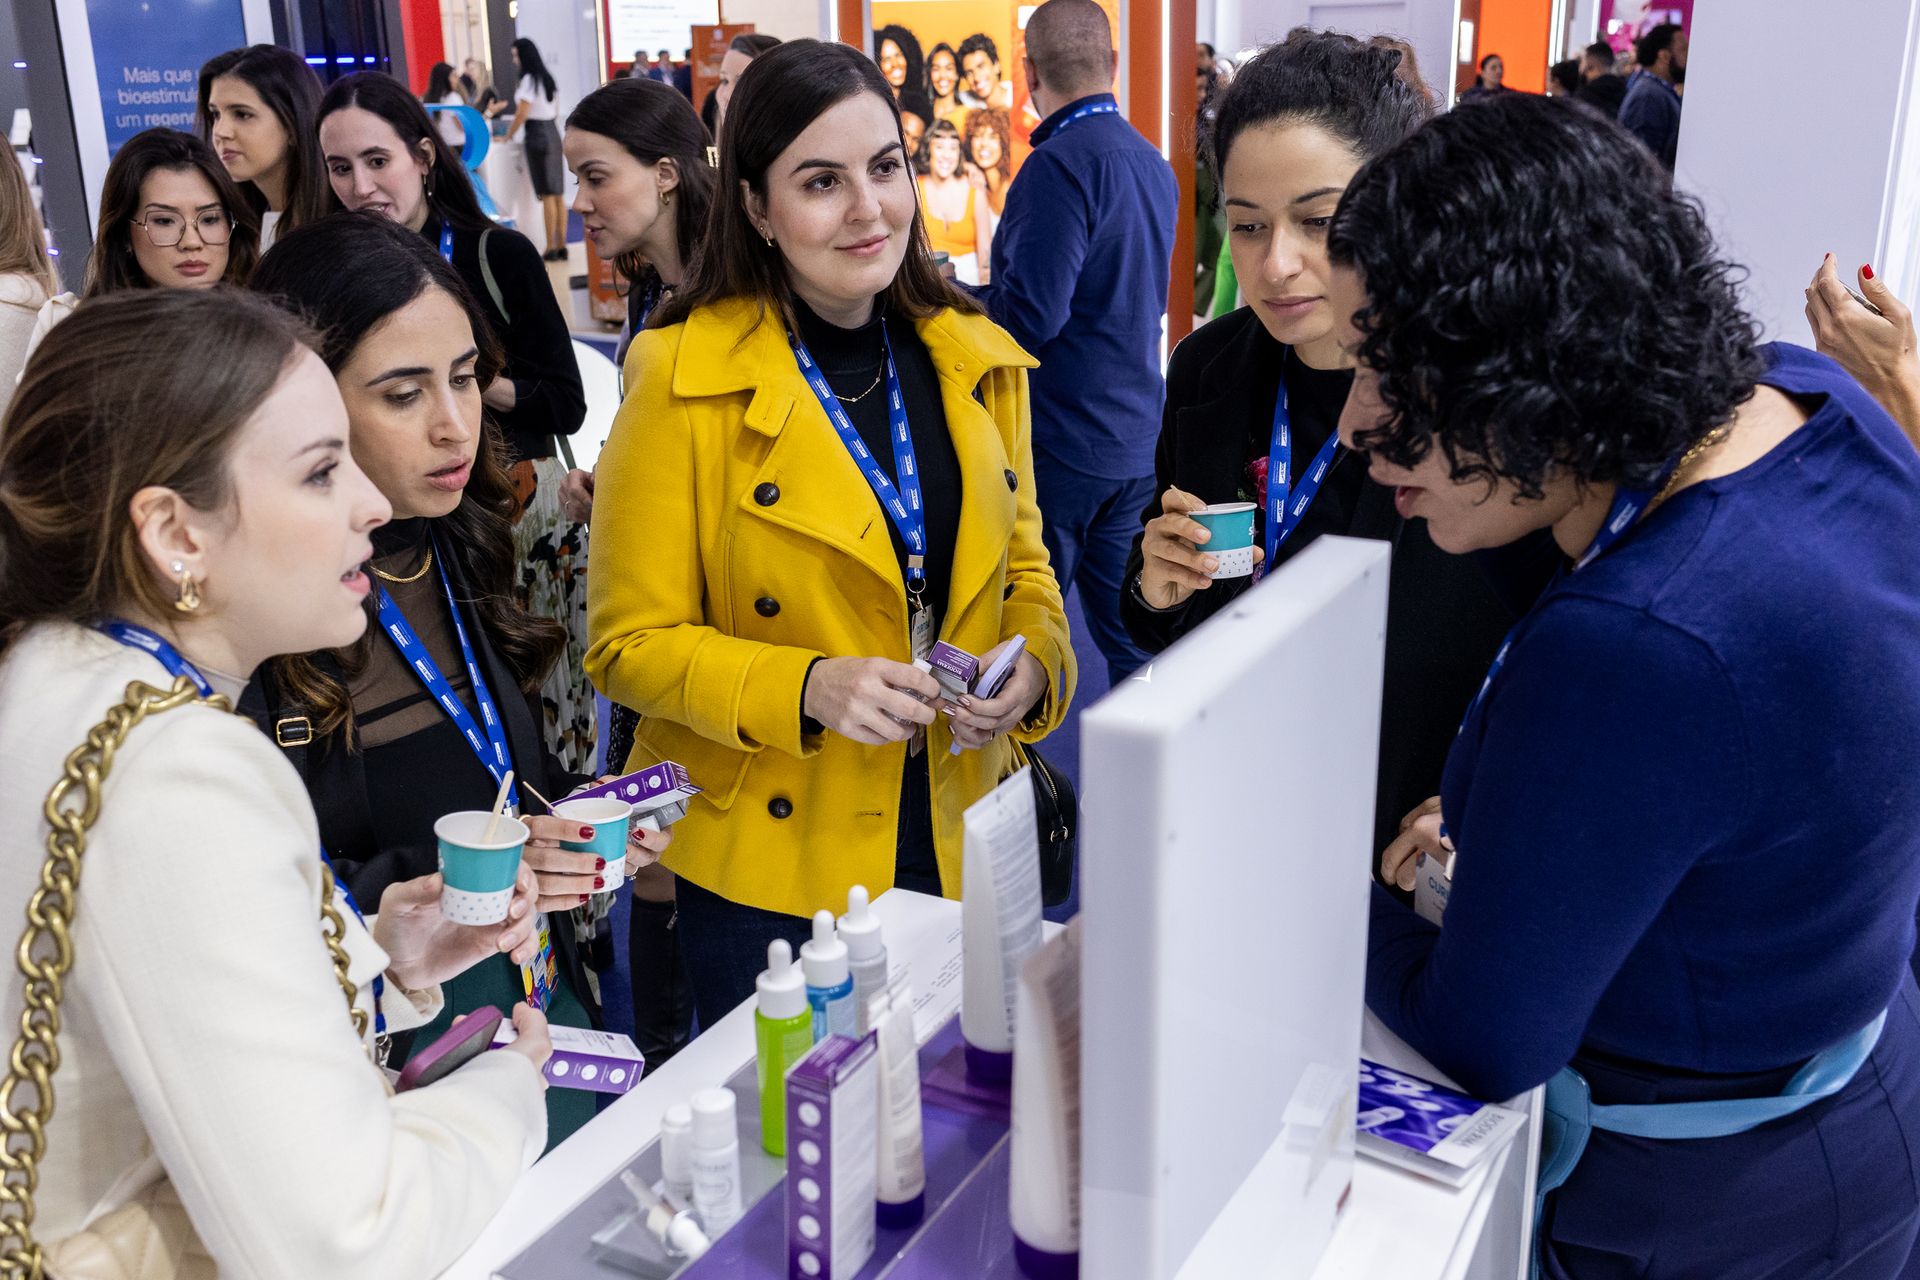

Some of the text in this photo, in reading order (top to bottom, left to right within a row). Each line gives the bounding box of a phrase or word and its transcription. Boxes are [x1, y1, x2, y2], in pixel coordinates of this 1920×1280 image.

[123, 67, 160, 84] Mais
[163, 69, 192, 86] que
[116, 114, 140, 128] um
